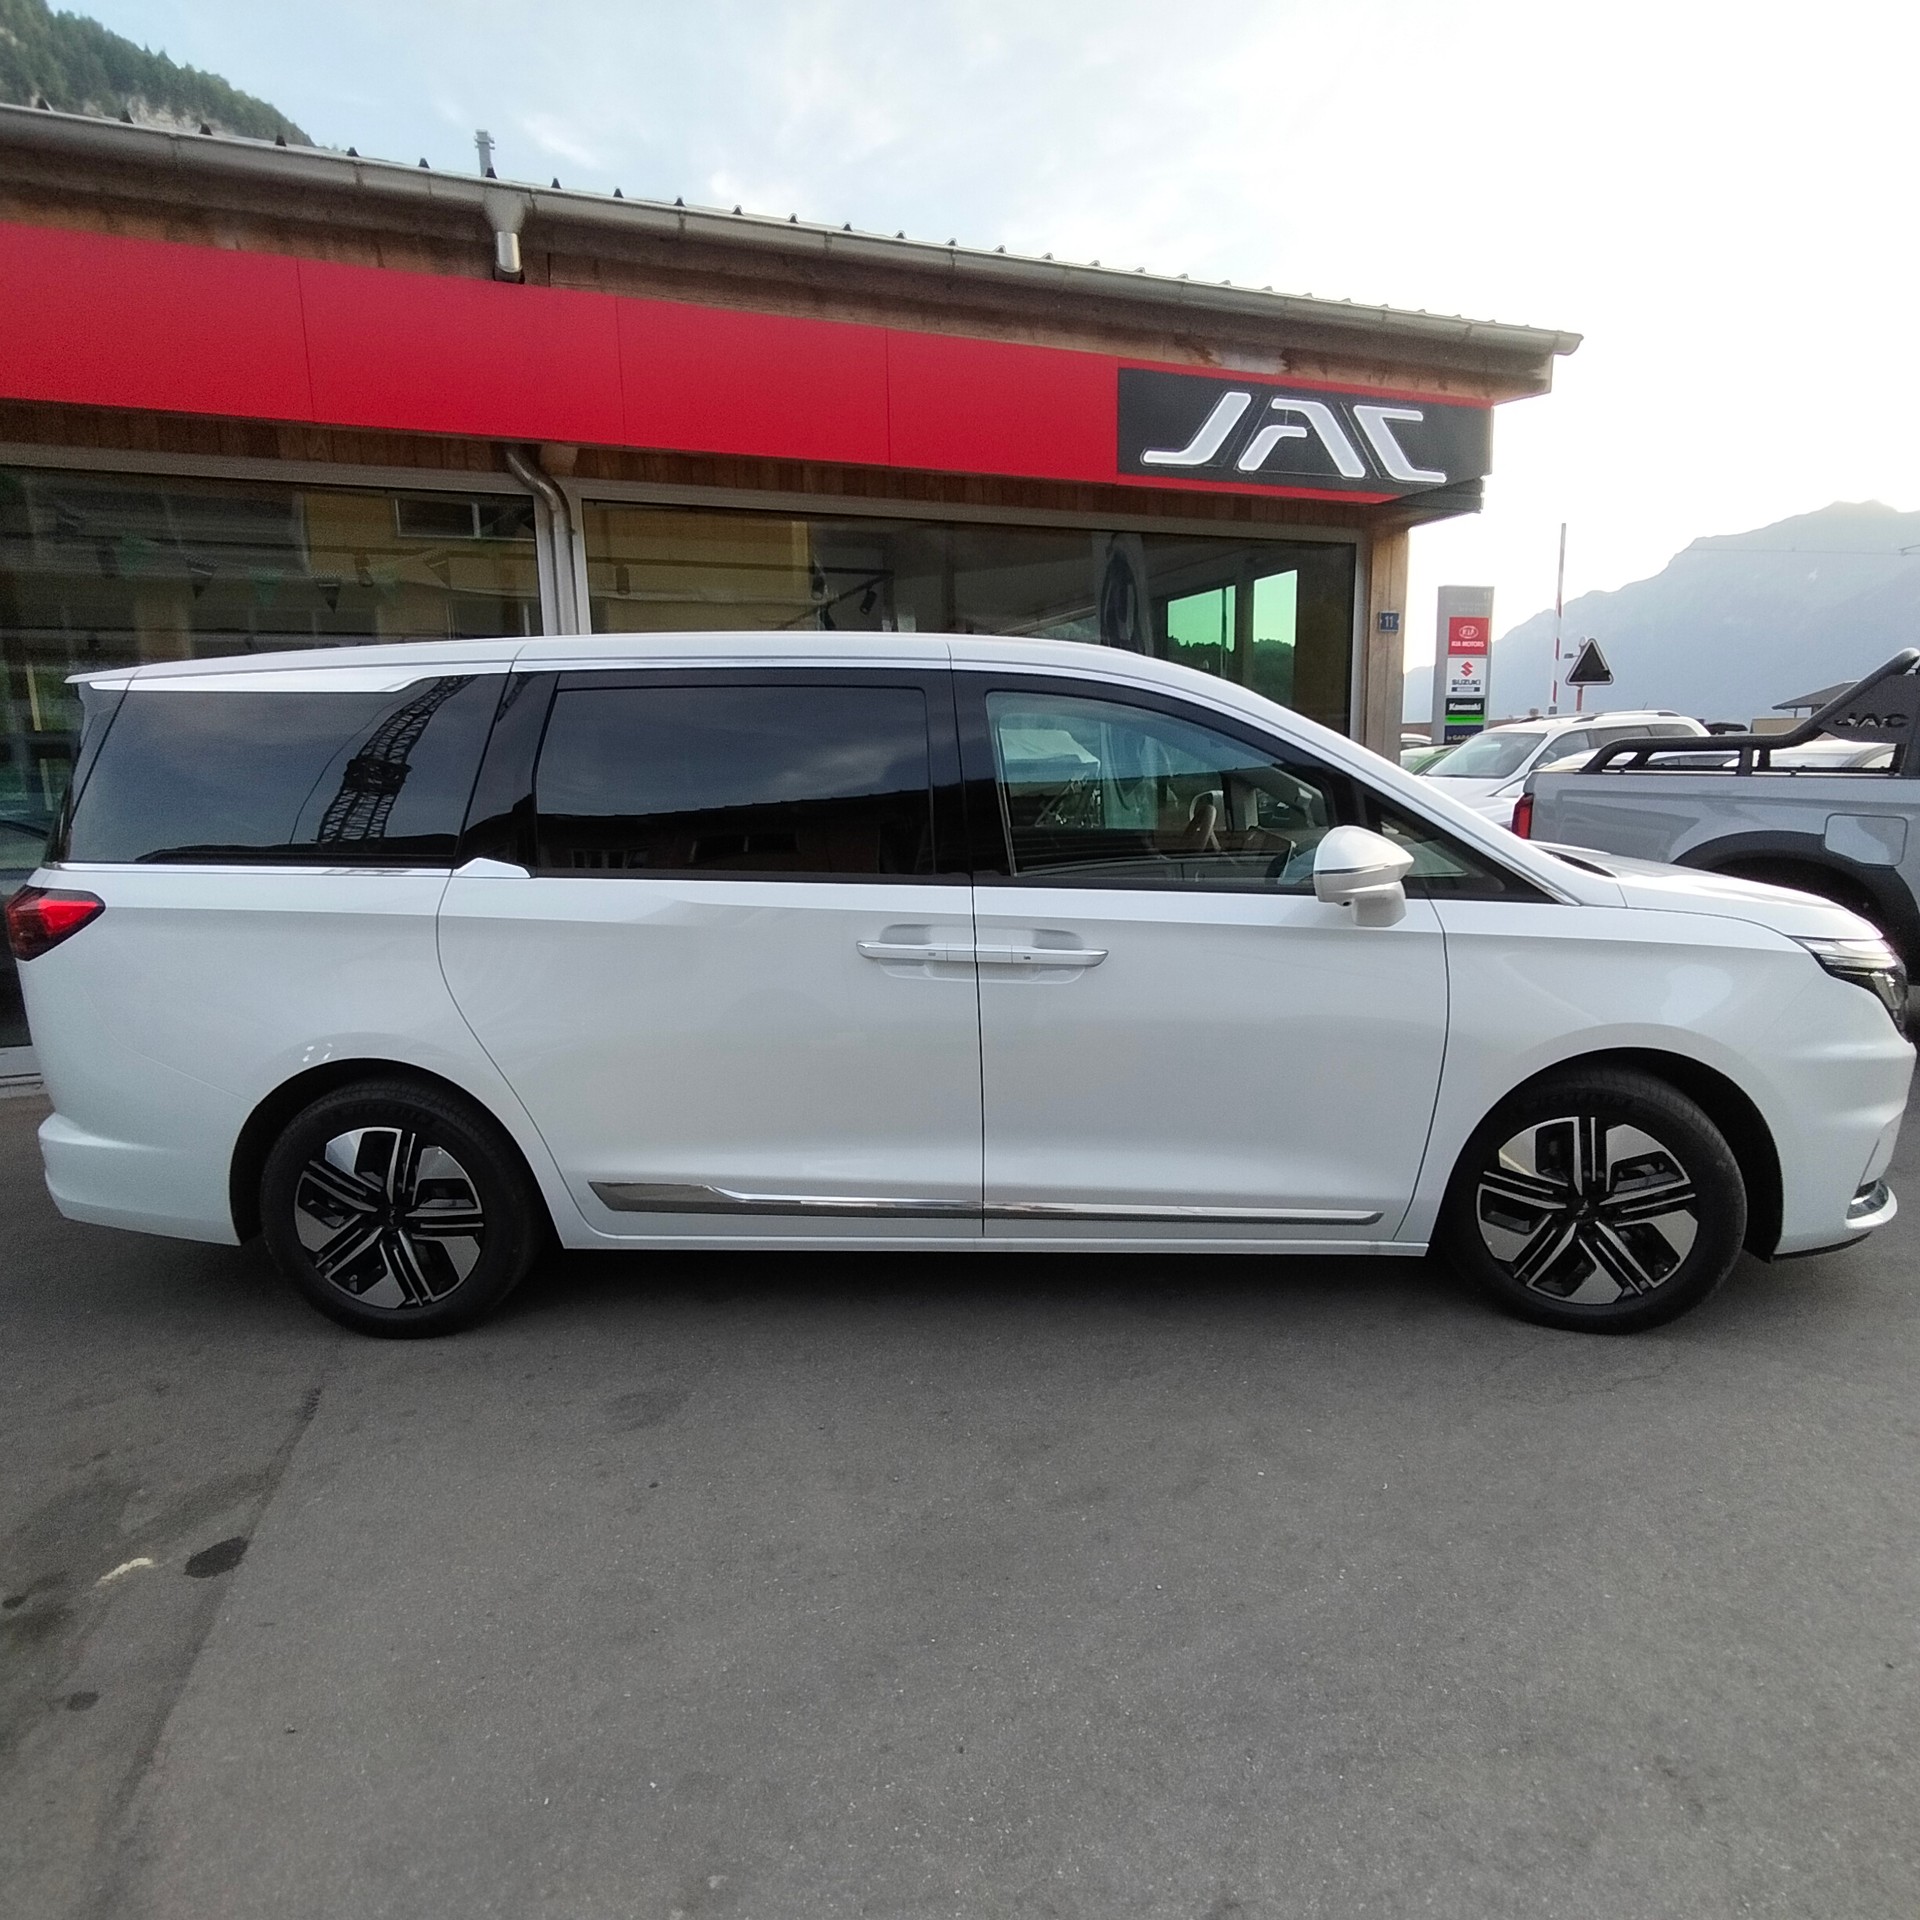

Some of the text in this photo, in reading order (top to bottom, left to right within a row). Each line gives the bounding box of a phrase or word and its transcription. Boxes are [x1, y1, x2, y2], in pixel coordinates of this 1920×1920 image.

[1142, 391, 1447, 483] JAC
[1385, 615, 1394, 628] 11
[1449, 703, 1482, 711] Kawasaki
[1835, 713, 1909, 728] JAC
